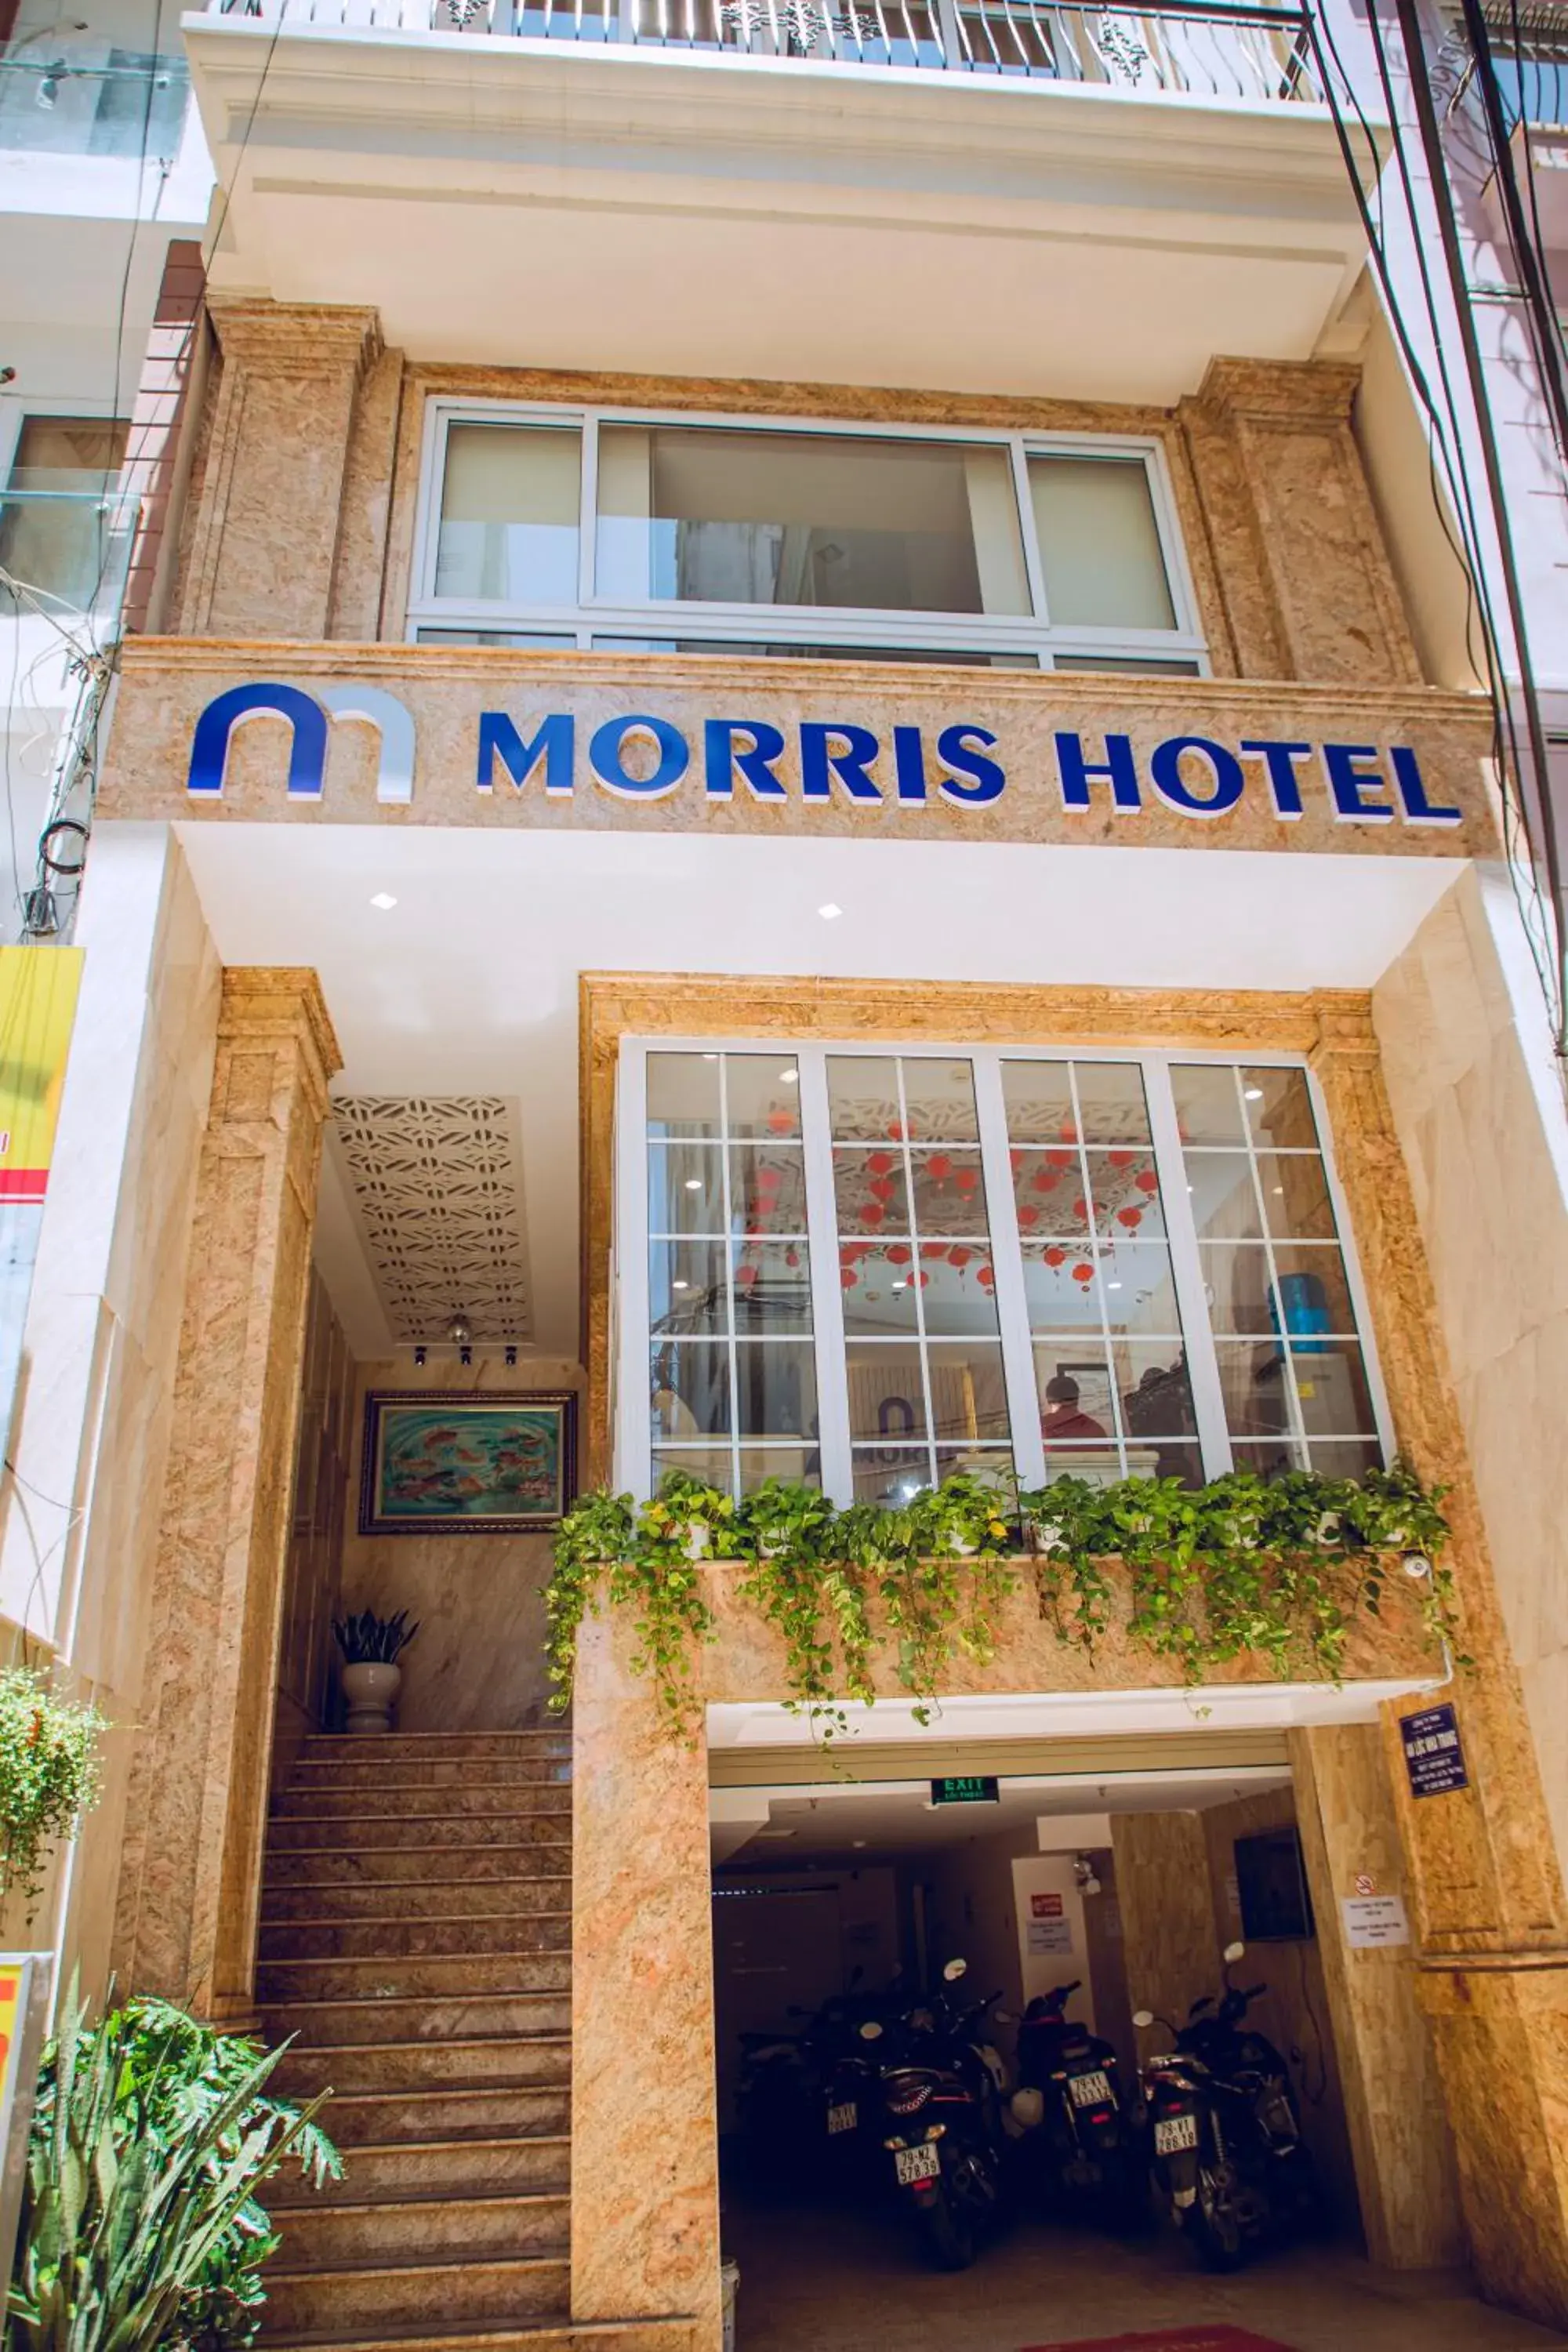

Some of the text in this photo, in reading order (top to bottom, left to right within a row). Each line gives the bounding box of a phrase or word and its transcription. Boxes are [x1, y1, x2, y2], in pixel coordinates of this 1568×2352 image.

[477, 711, 1463, 826] MORRIS HOTEL
[946, 1779, 982, 1791] EXIT
